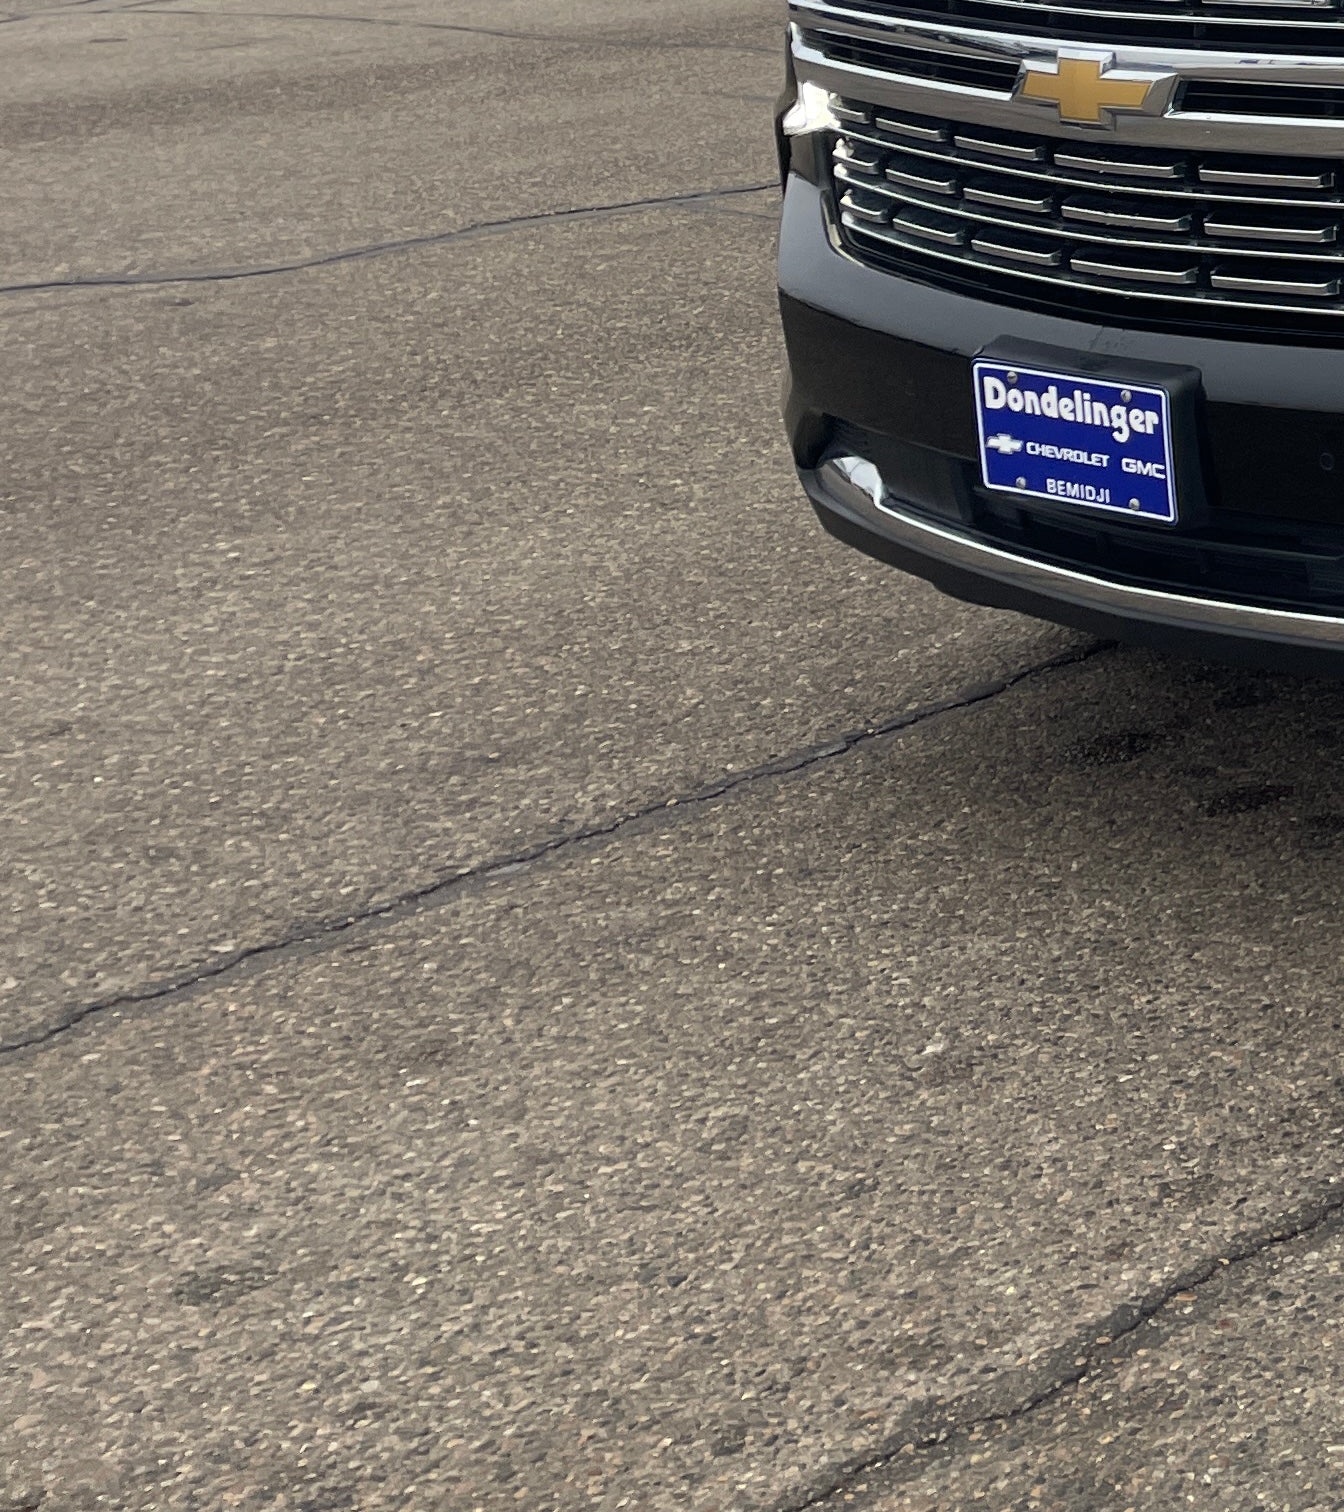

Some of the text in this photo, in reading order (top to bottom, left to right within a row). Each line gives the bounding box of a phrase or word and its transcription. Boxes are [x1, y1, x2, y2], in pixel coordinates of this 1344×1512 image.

[982, 375, 1160, 443] Dondelinger
[1025, 441, 1166, 479] CHEVROLET GMC
[1046, 478, 1111, 504] BEMIDJI
